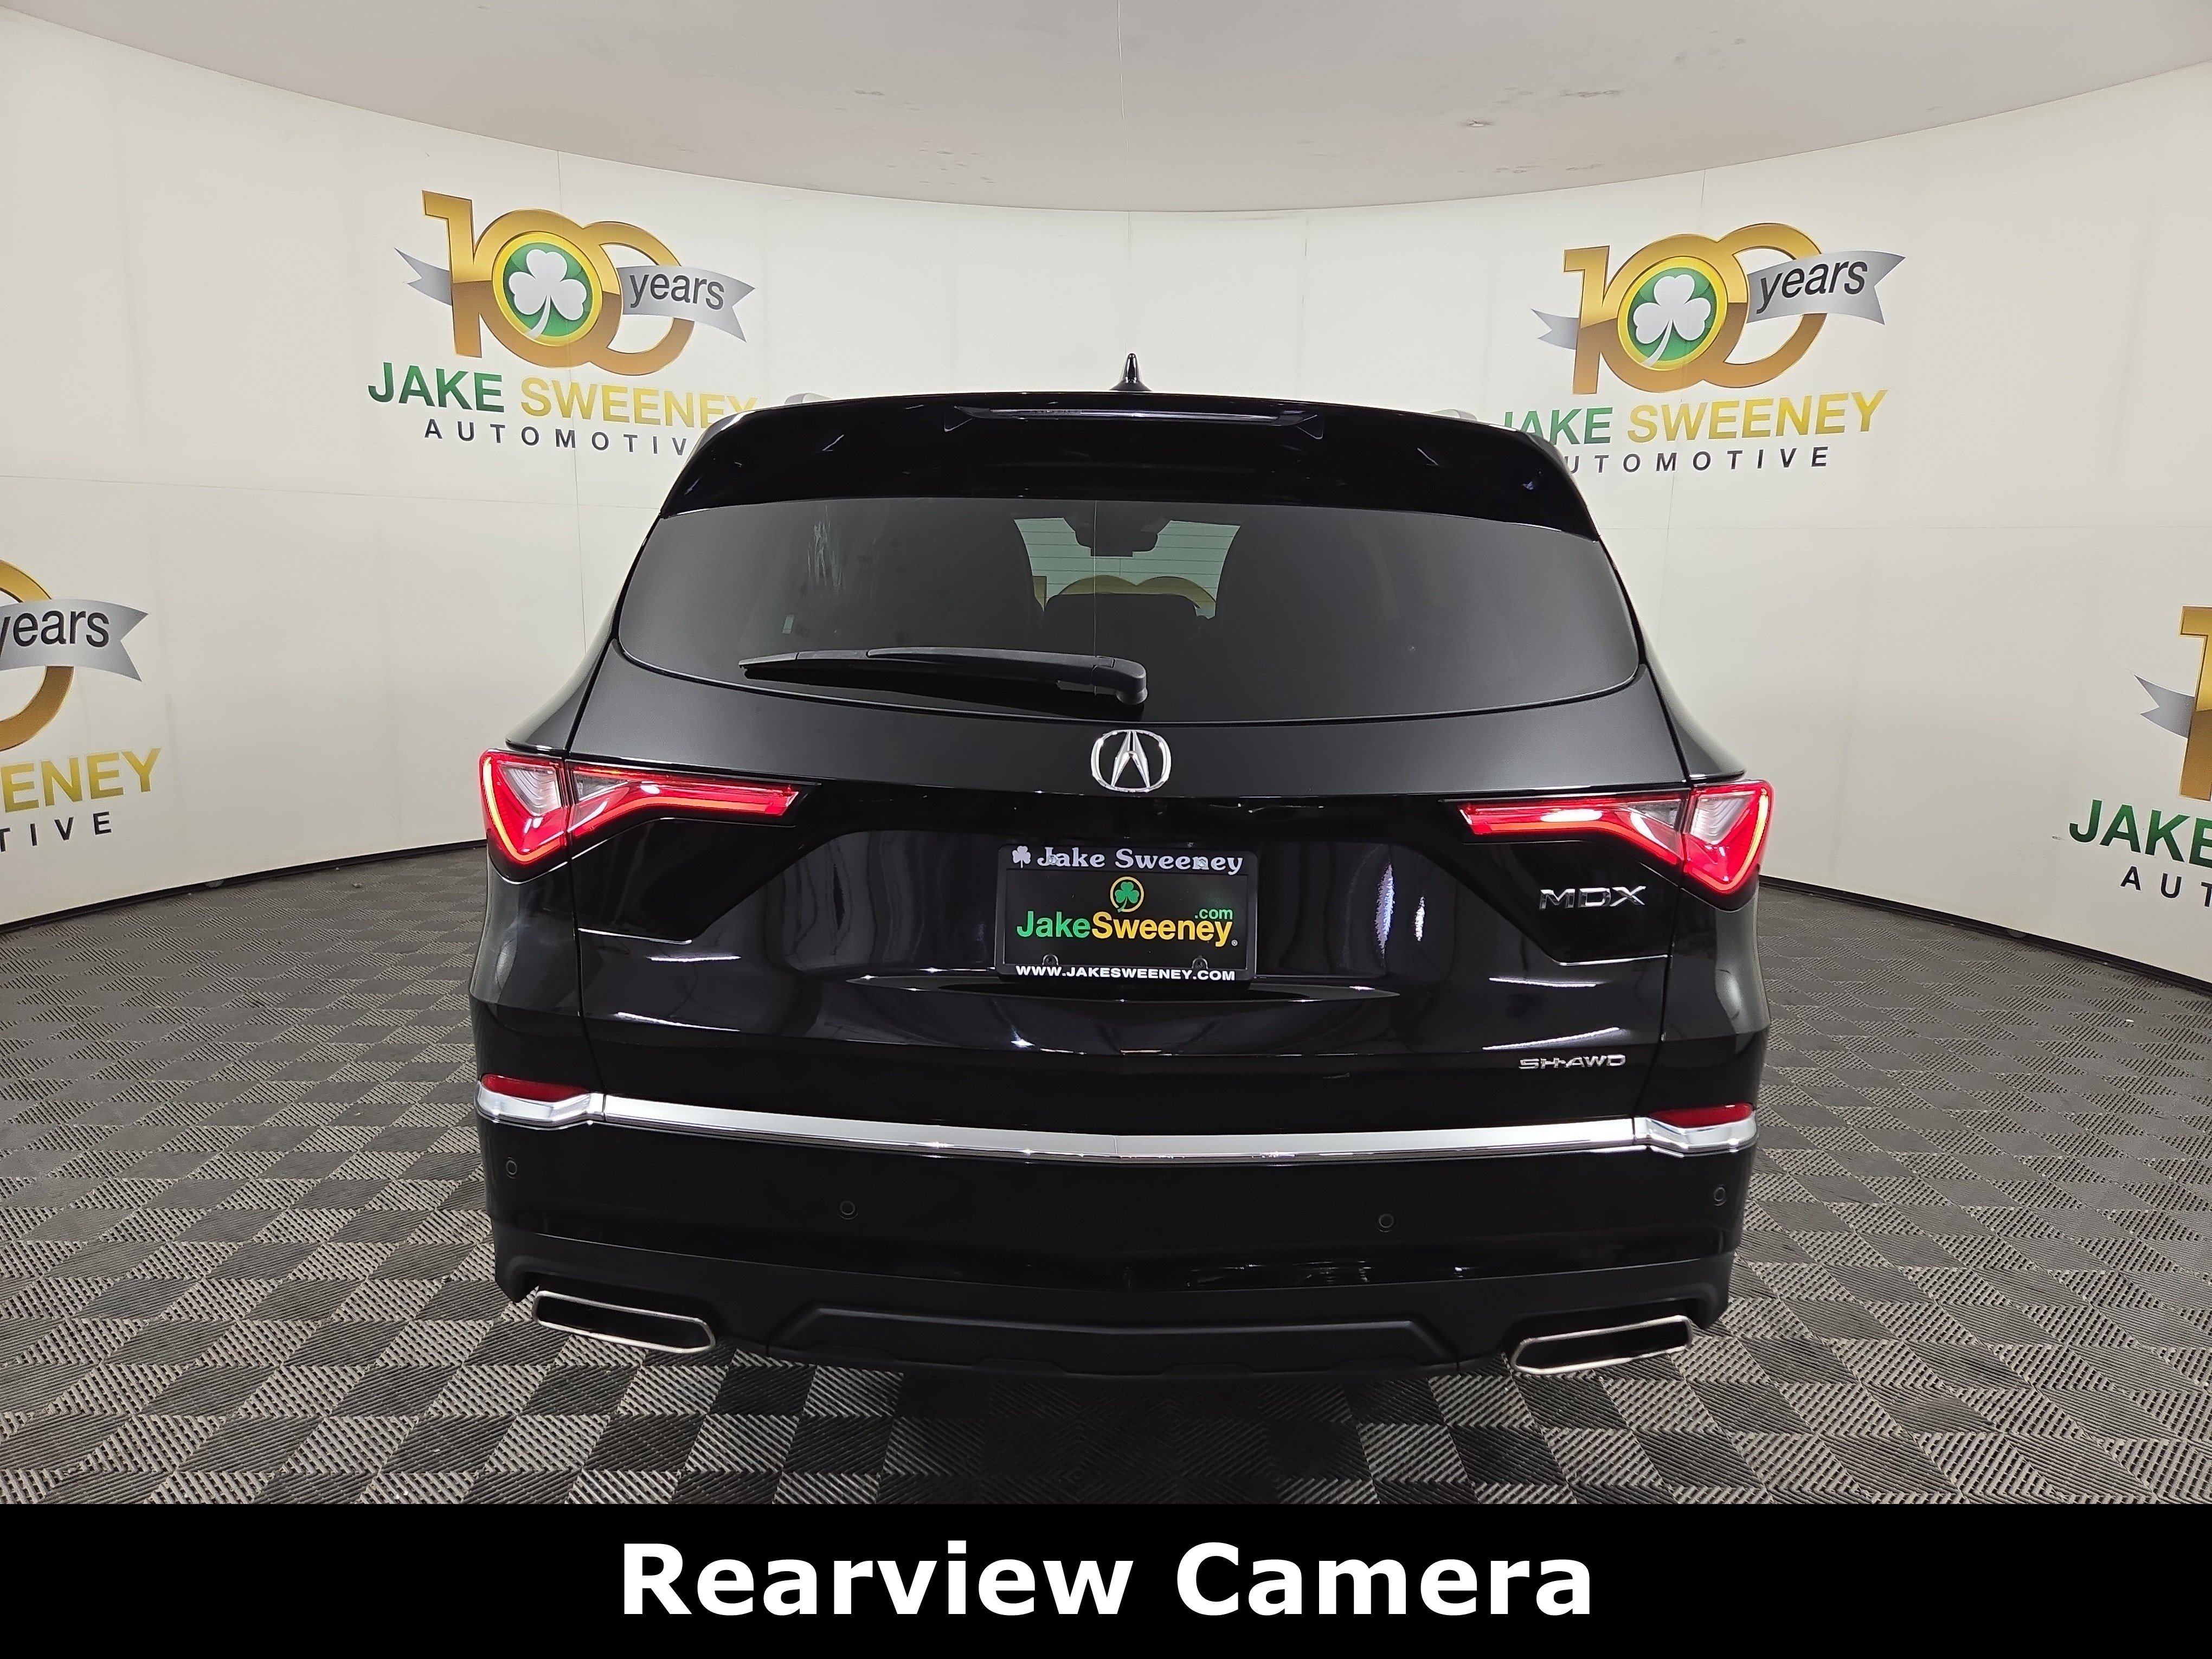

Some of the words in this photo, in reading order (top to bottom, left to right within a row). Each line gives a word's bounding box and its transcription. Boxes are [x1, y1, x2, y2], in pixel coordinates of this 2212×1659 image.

[422, 190, 695, 376] 100
[629, 273, 725, 311] years
[1564, 222, 1828, 395] 100
[1756, 260, 1868, 315] years
[368, 362, 505, 413] JAKE
[424, 418, 687, 456] AUTOMOTIV
[1627, 389, 1888, 443] SWEENEY
[1564, 445, 1829, 474] UTOMOTIVE
[0, 748, 162, 813] ENEY
[2069, 799, 2212, 869] JAKE
[1037, 847, 1105, 867] Jake
[1115, 848, 1243, 876] Sweeney
[1539, 885, 1646, 910] MDX
[1015, 965, 1235, 981] WWW.JAKESWEENEY.COM
[1518, 1054, 1626, 1070] SH-AWD
